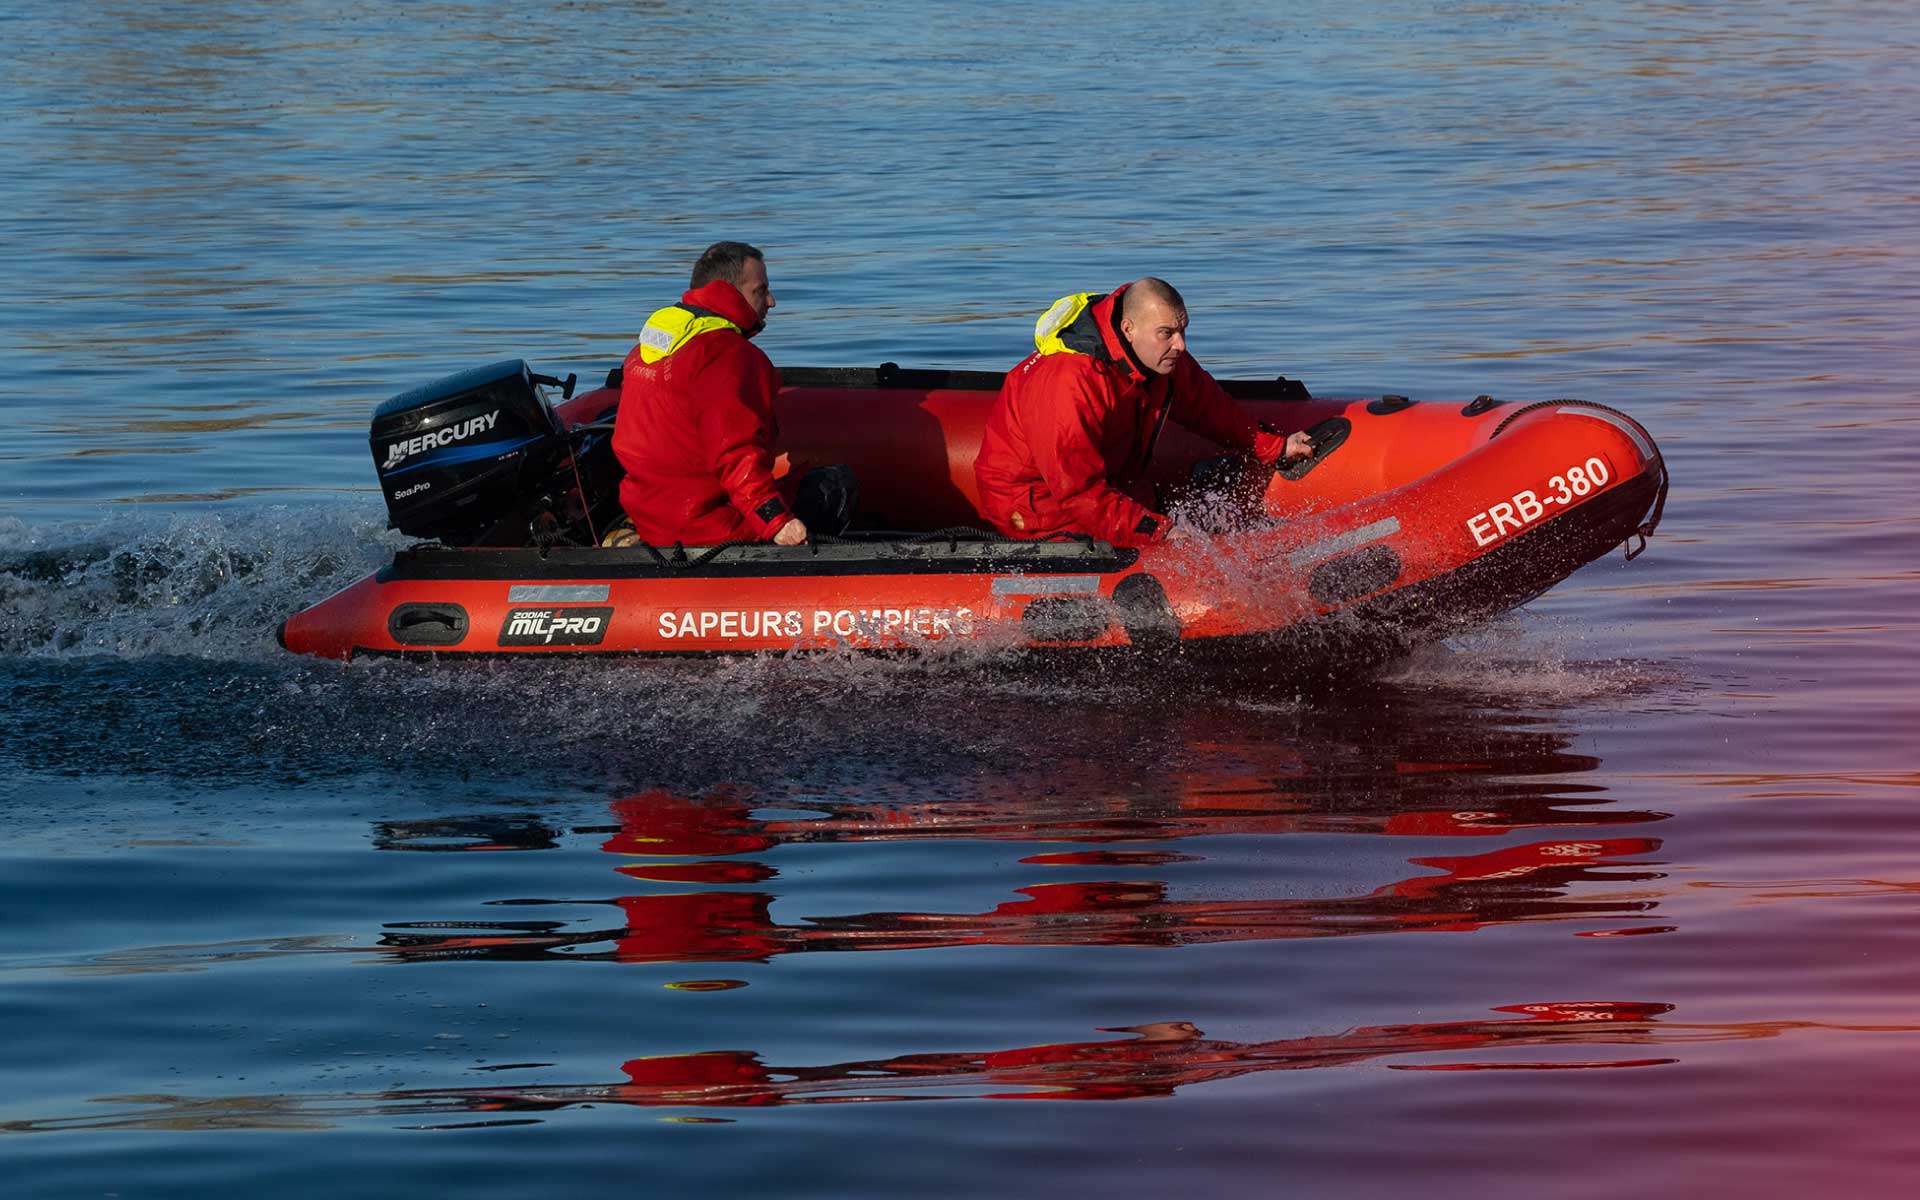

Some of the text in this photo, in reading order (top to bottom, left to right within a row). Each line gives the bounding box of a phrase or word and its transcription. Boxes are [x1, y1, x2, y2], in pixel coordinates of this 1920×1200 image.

[385, 409, 500, 466] MERCURY
[1466, 457, 1609, 547] ERB-380
[513, 611, 553, 619] ZODIAC
[658, 610, 803, 638] SAPEURS
